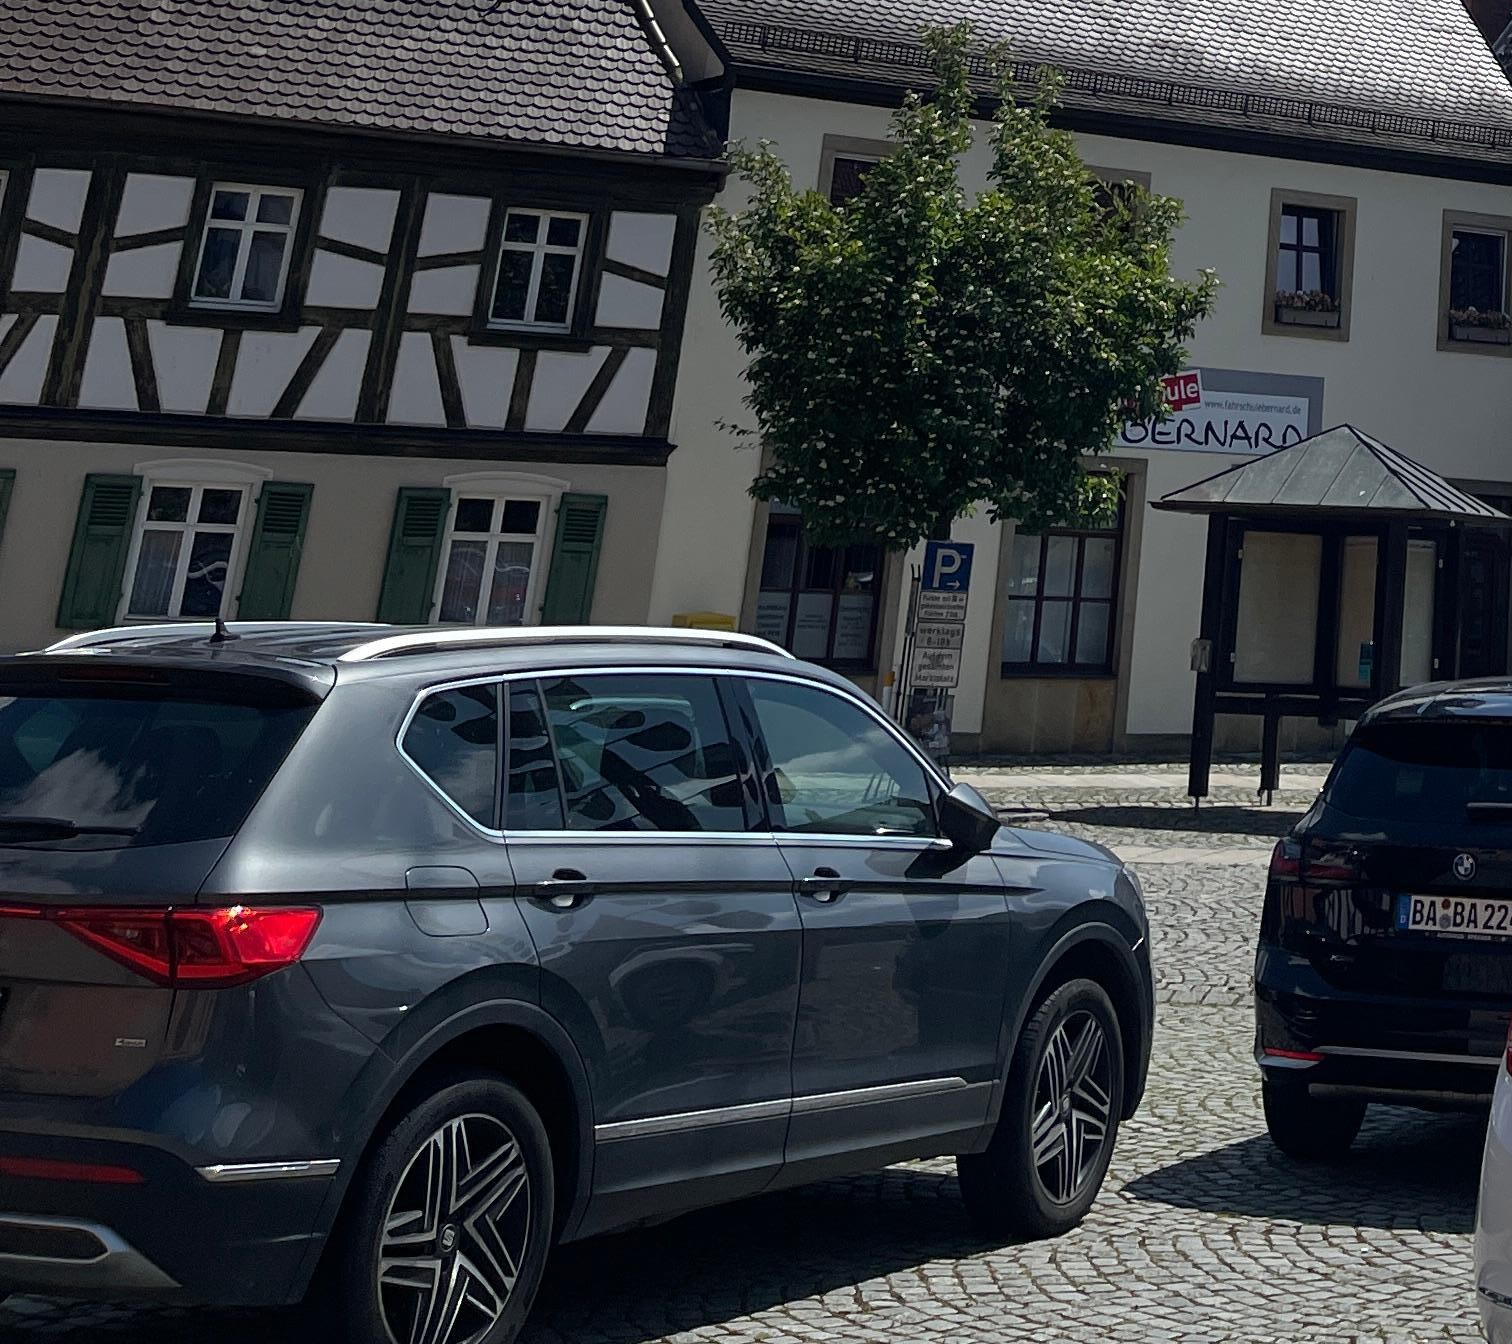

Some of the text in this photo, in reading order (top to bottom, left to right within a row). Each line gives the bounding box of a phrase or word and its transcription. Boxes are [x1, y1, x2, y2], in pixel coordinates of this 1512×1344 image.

[932, 548, 962, 588] P
[1411, 899, 1437, 927] BA
[1452, 901, 1478, 929] BA
